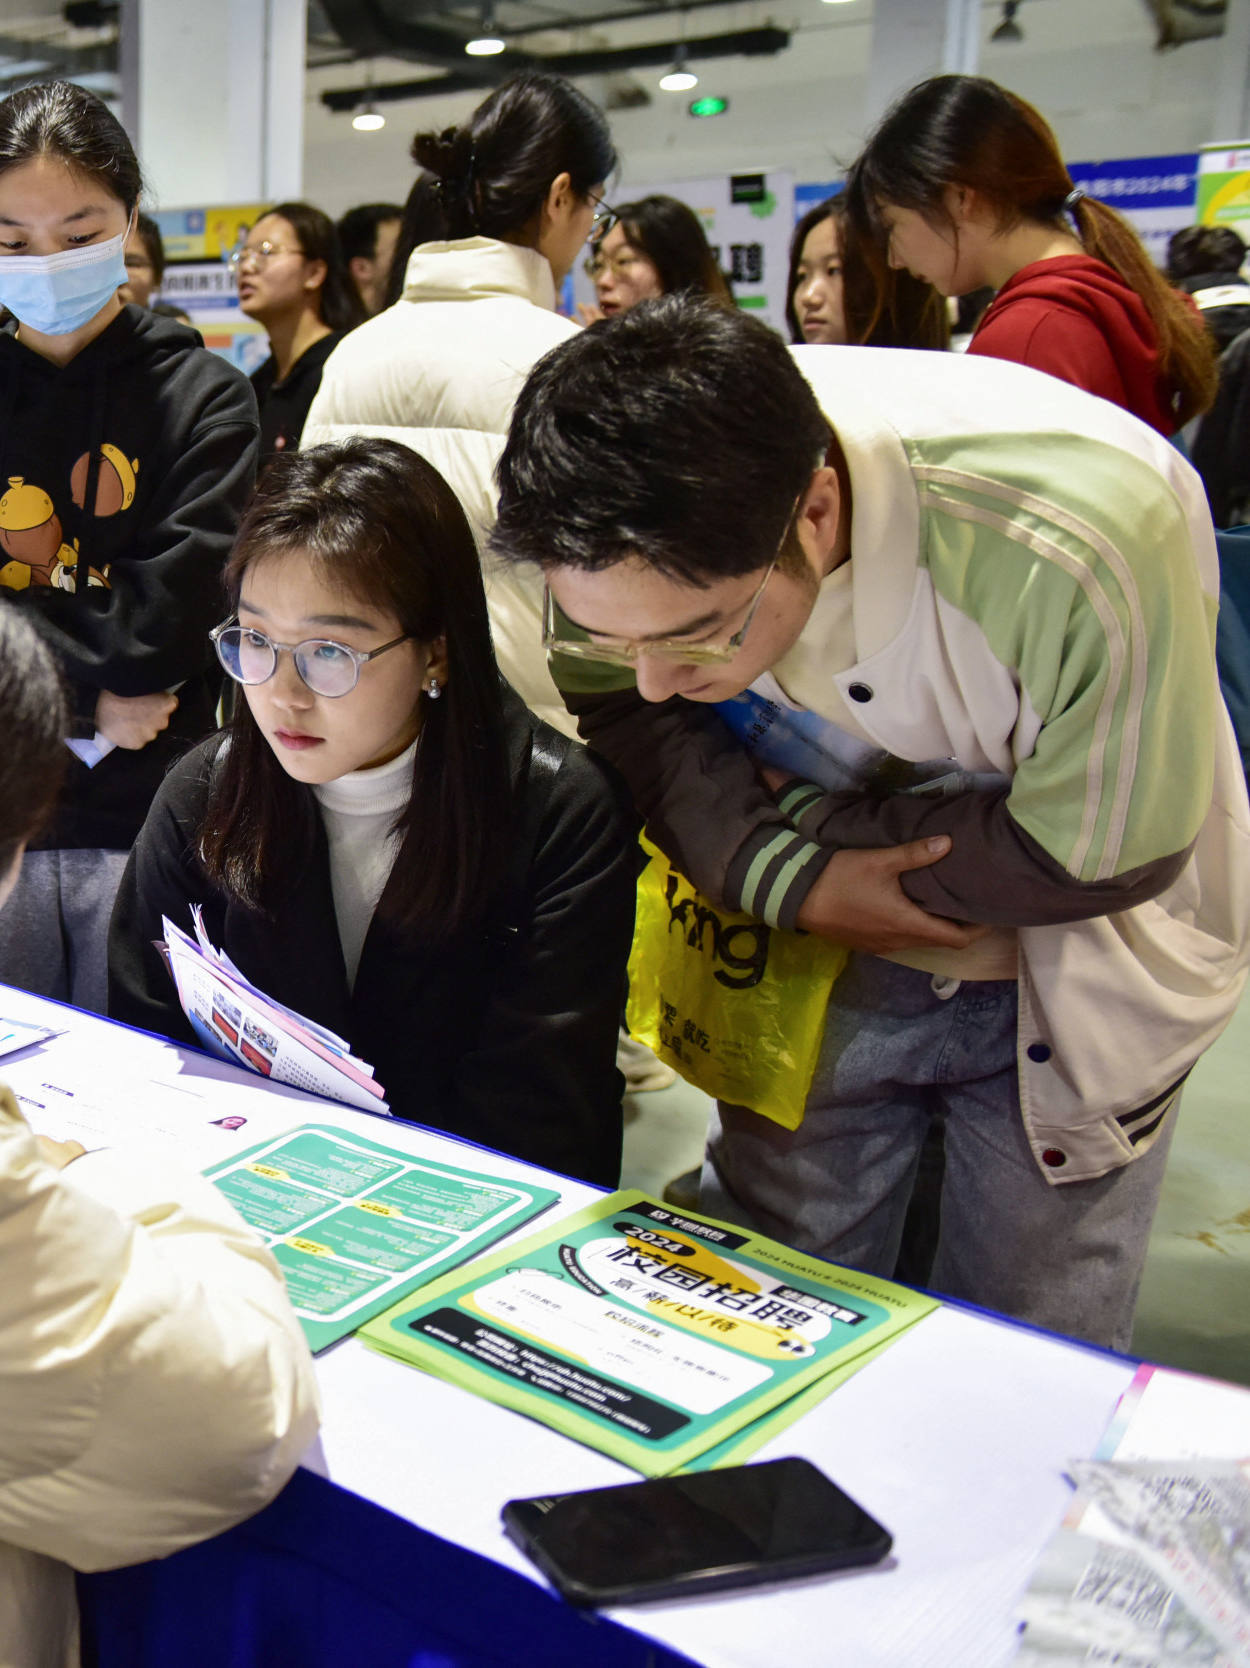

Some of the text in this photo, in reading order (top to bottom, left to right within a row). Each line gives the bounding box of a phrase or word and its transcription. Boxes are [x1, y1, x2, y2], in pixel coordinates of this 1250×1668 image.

[623, 1225, 685, 1253] 2024
[605, 1245, 815, 1332] 校园招聘
